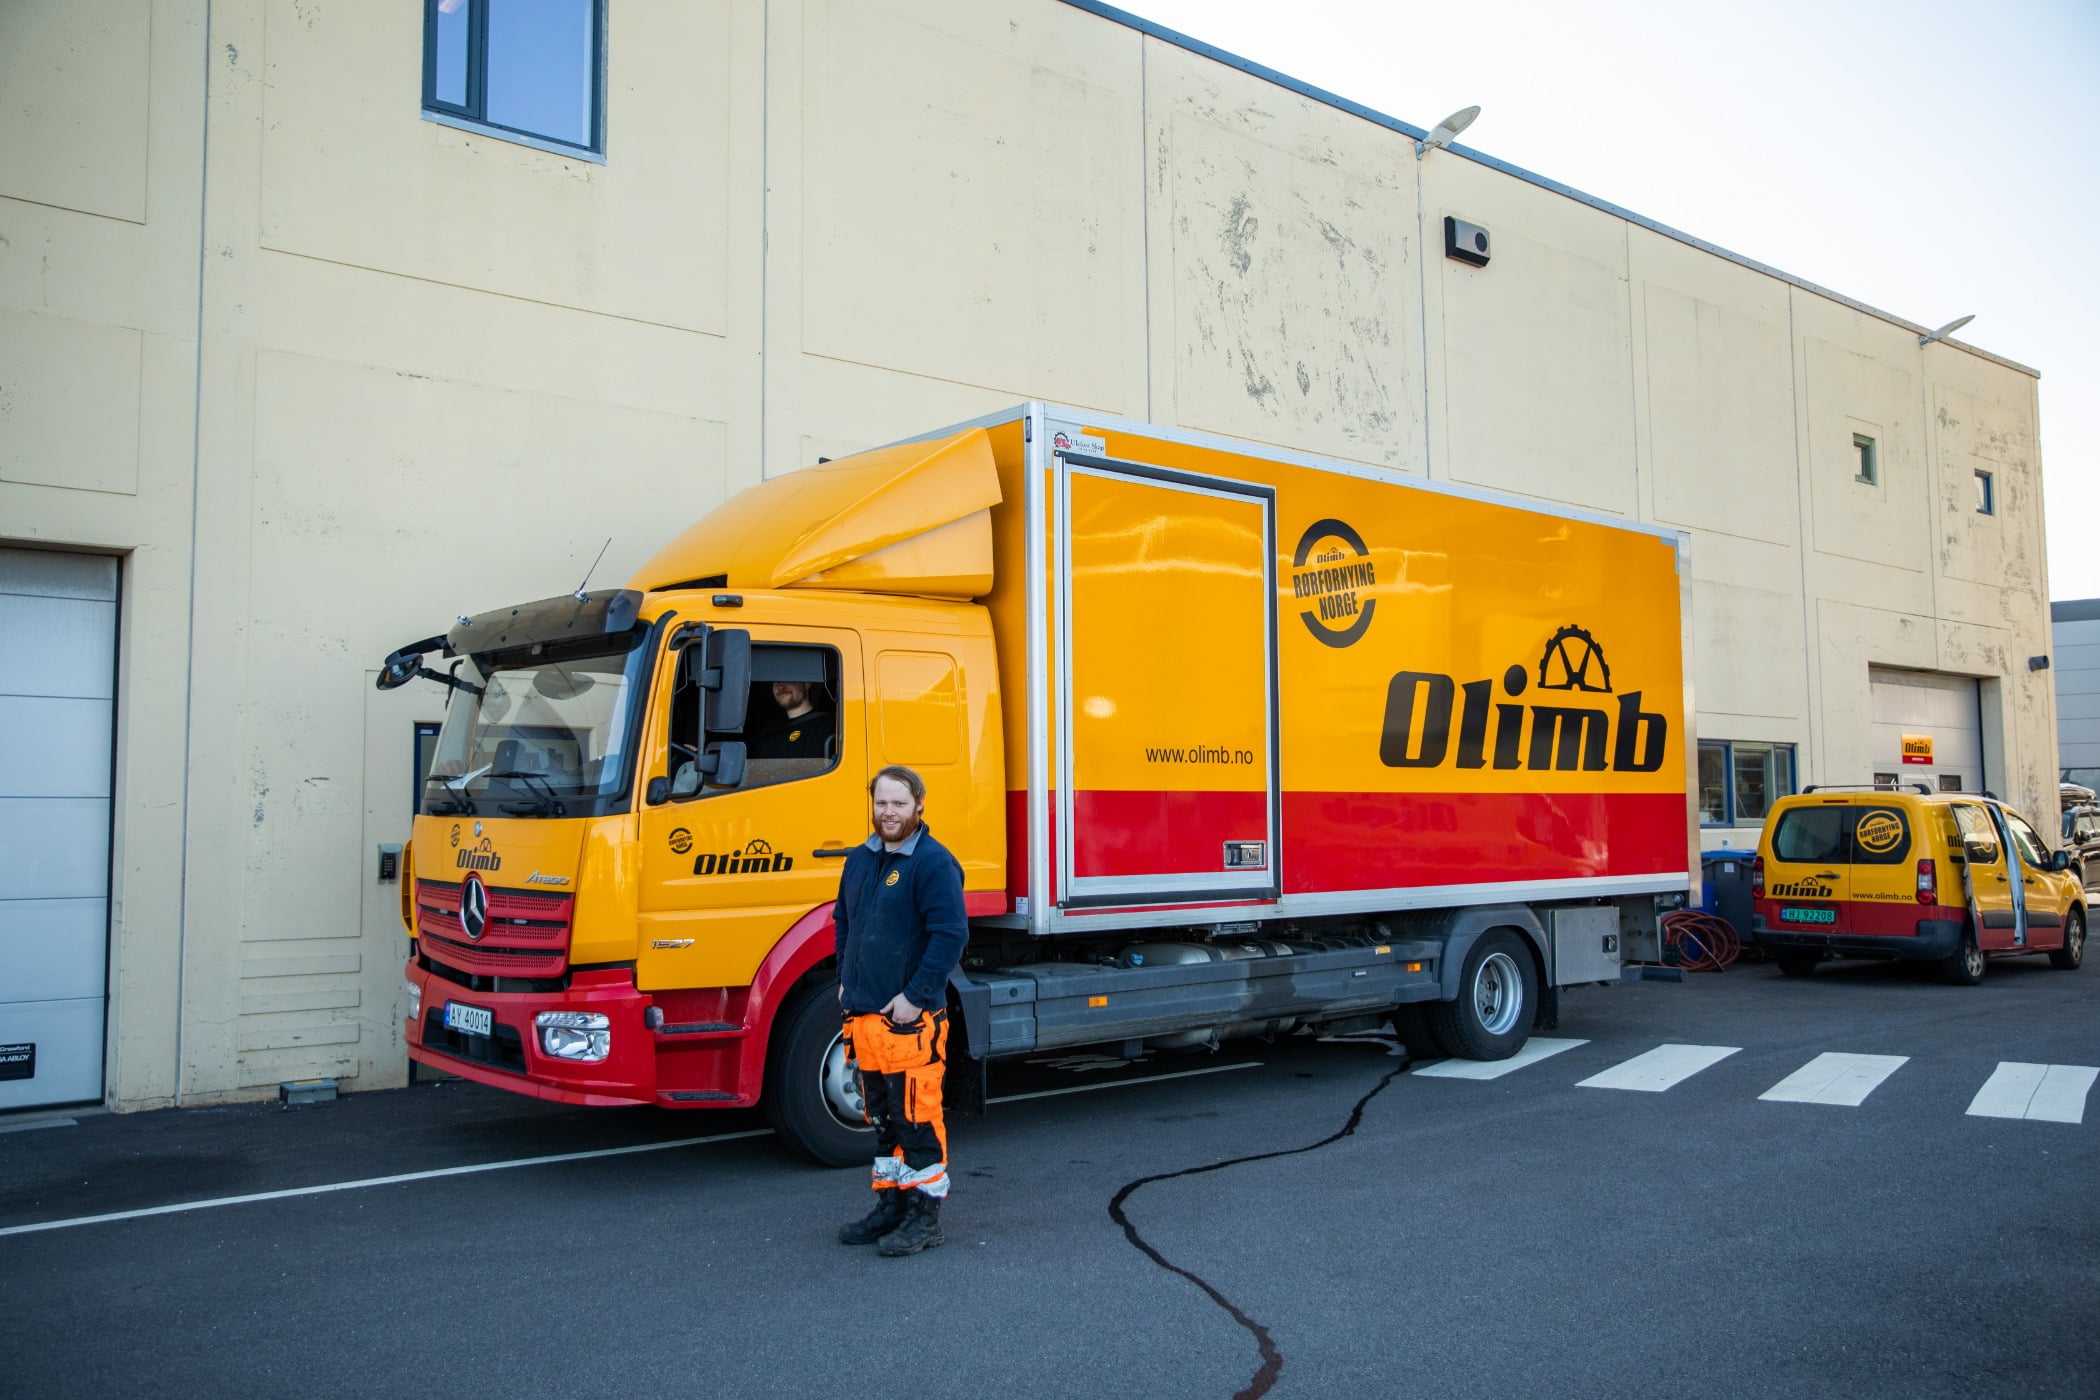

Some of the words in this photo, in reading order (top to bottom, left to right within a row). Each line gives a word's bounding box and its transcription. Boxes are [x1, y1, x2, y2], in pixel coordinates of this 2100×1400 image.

[1292, 562, 1376, 599] RØRFORNYING
[1318, 591, 1359, 621] NORGE
[1379, 664, 1667, 773] Olimb
[1145, 744, 1254, 765] www.olimb.no
[1904, 741, 1930, 754] Olimb
[456, 846, 501, 871] Olimb
[692, 849, 794, 875] Olimb
[1771, 882, 1833, 897] Olimb
[1852, 891, 1913, 901] www.olimb.no
[1788, 910, 1800, 920] HJ
[1803, 910, 1833, 921] 92208
[652, 938, 696, 950] 1527
[451, 1006, 462, 1025] AY
[465, 1009, 489, 1032] 40014
